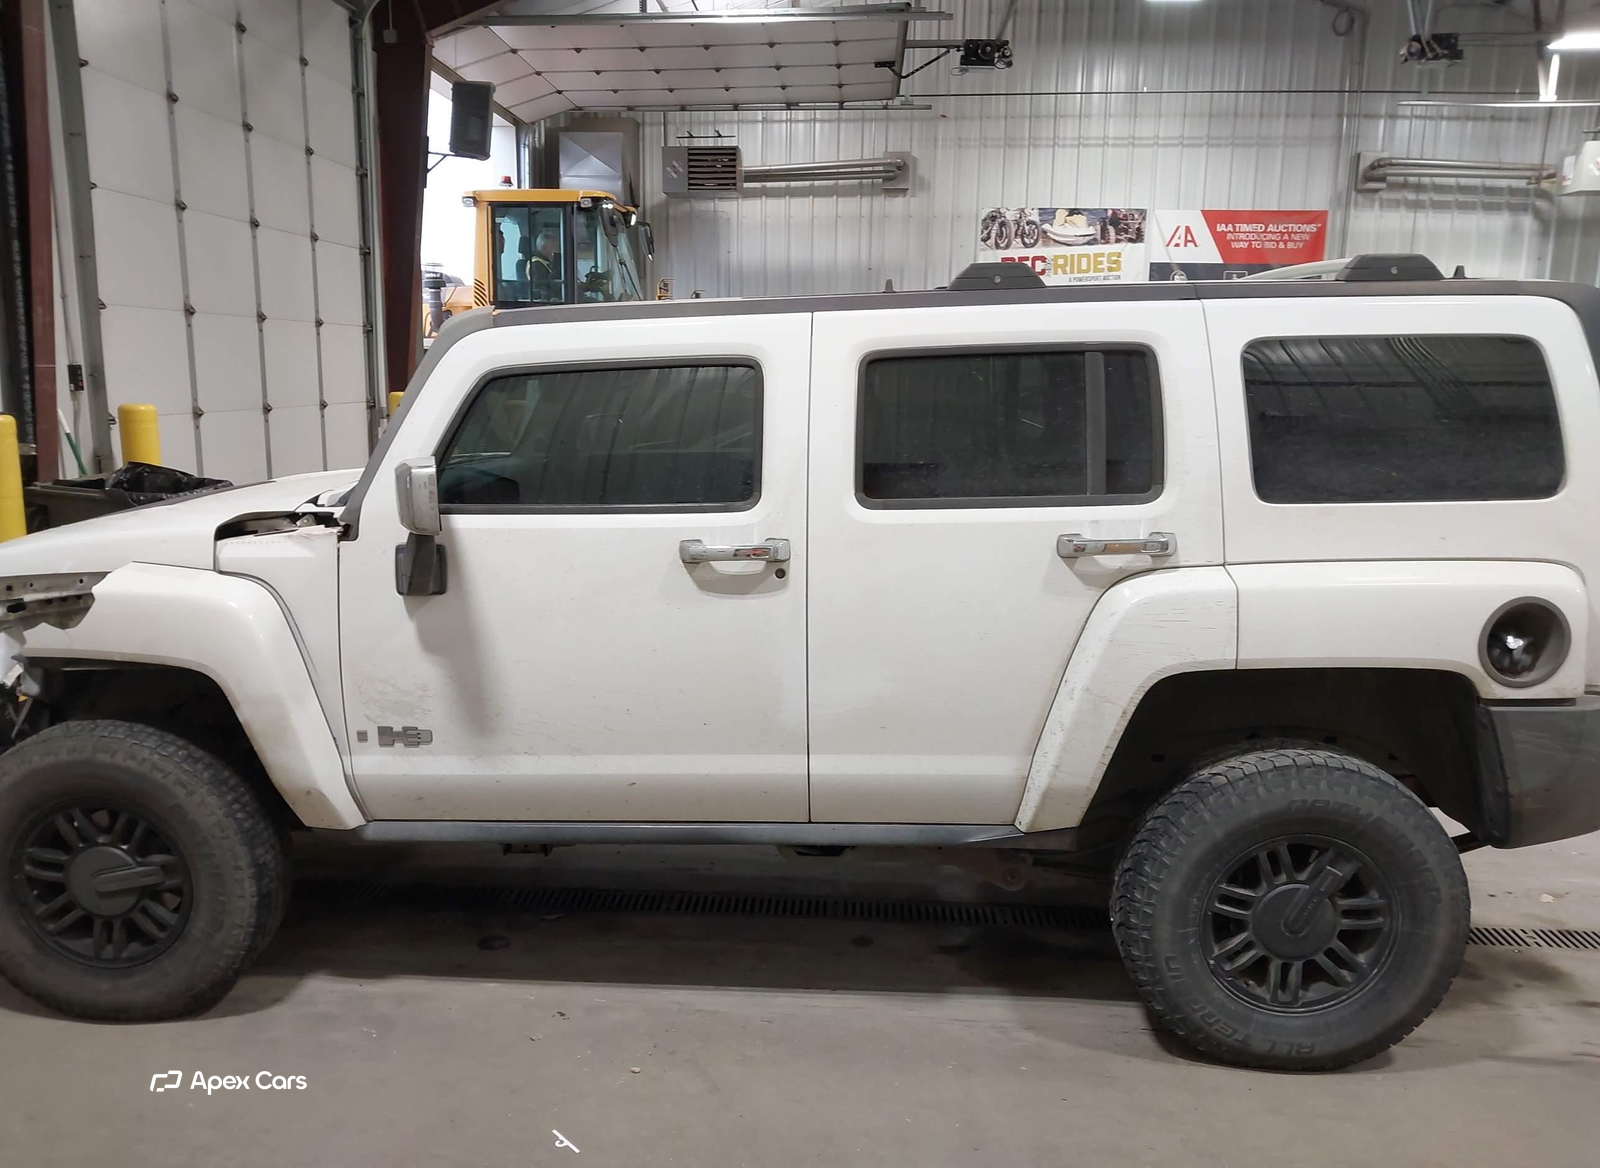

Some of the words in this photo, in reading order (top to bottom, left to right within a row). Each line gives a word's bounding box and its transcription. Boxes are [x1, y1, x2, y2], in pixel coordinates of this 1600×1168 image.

[1216, 223, 1234, 232] IAA
[1234, 223, 1266, 232] TIMED
[1226, 233, 1281, 241] INTRODUCING
[1282, 233, 1290, 241] A
[1291, 233, 1310, 241] NEW
[1231, 241, 1250, 249] WAY
[1251, 241, 1263, 249] TO
[1278, 241, 1286, 249] &
[1287, 241, 1304, 249] BUY
[1053, 252, 1122, 276] RIDES
[377, 726, 433, 748] H3
